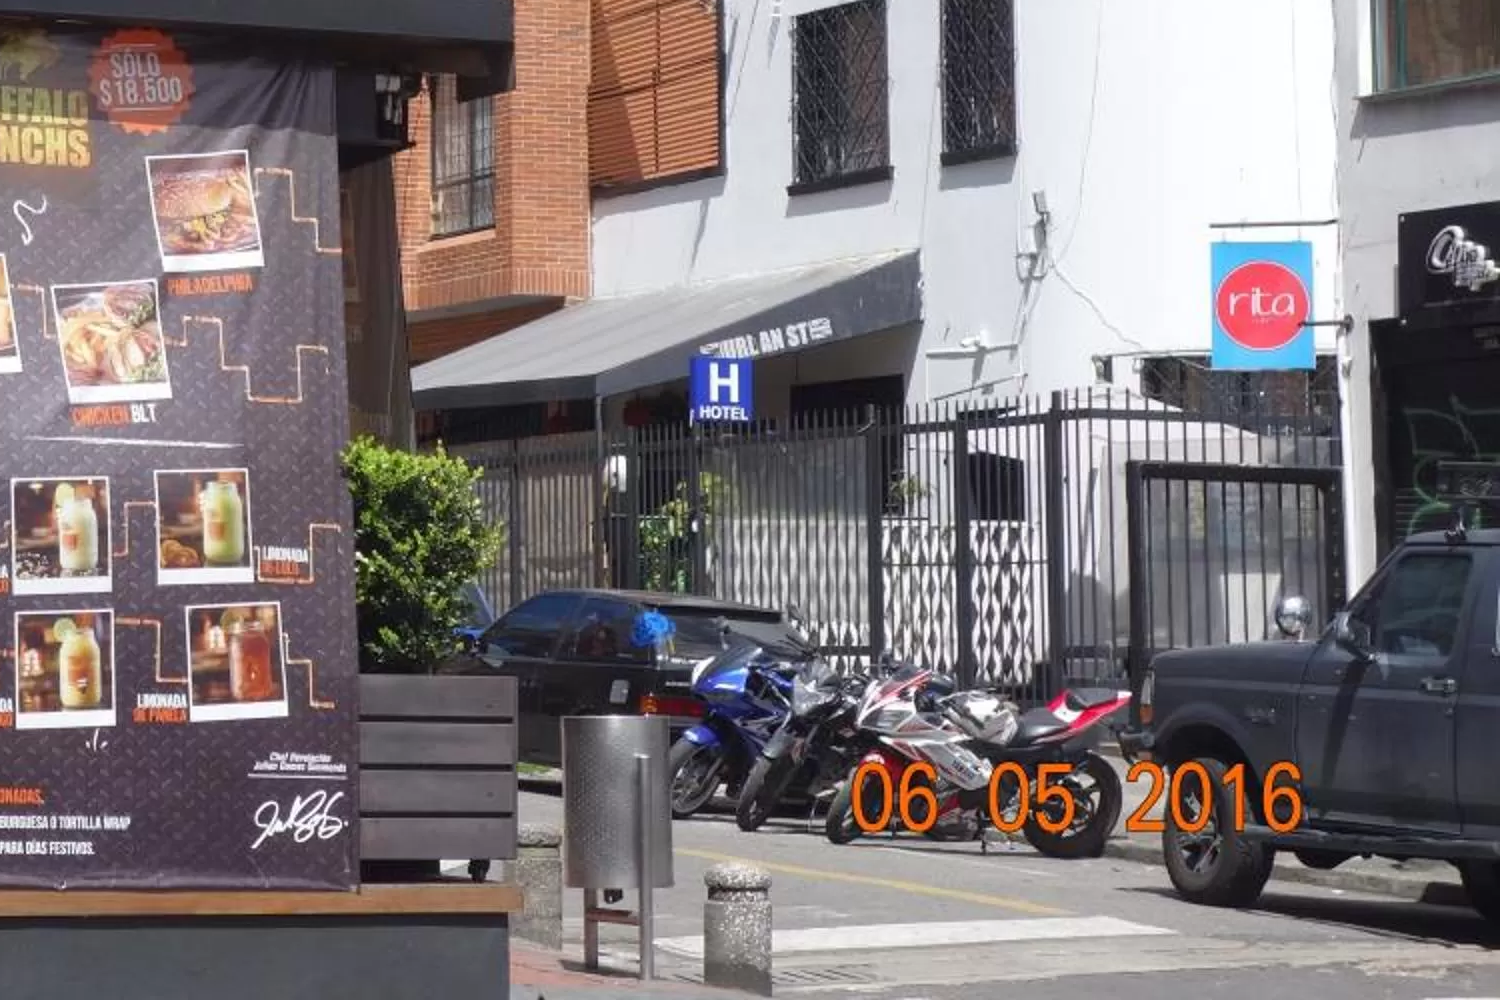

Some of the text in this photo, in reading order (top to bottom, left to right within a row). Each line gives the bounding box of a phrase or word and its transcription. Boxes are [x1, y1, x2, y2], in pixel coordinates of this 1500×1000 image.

[110, 48, 161, 78] SÓLO
[167, 273, 254, 296] PHILADELPHIA
[1228, 286, 1296, 318] rita
[709, 362, 740, 403] H
[72, 403, 156, 426] CHICKEN BLT
[700, 405, 749, 421] HOTEL
[261, 545, 308, 563] LIMONADA
[137, 693, 188, 708] LIMONADA
[58, 815, 102, 830] TORTILLA
[0, 841, 25, 855] PARA
